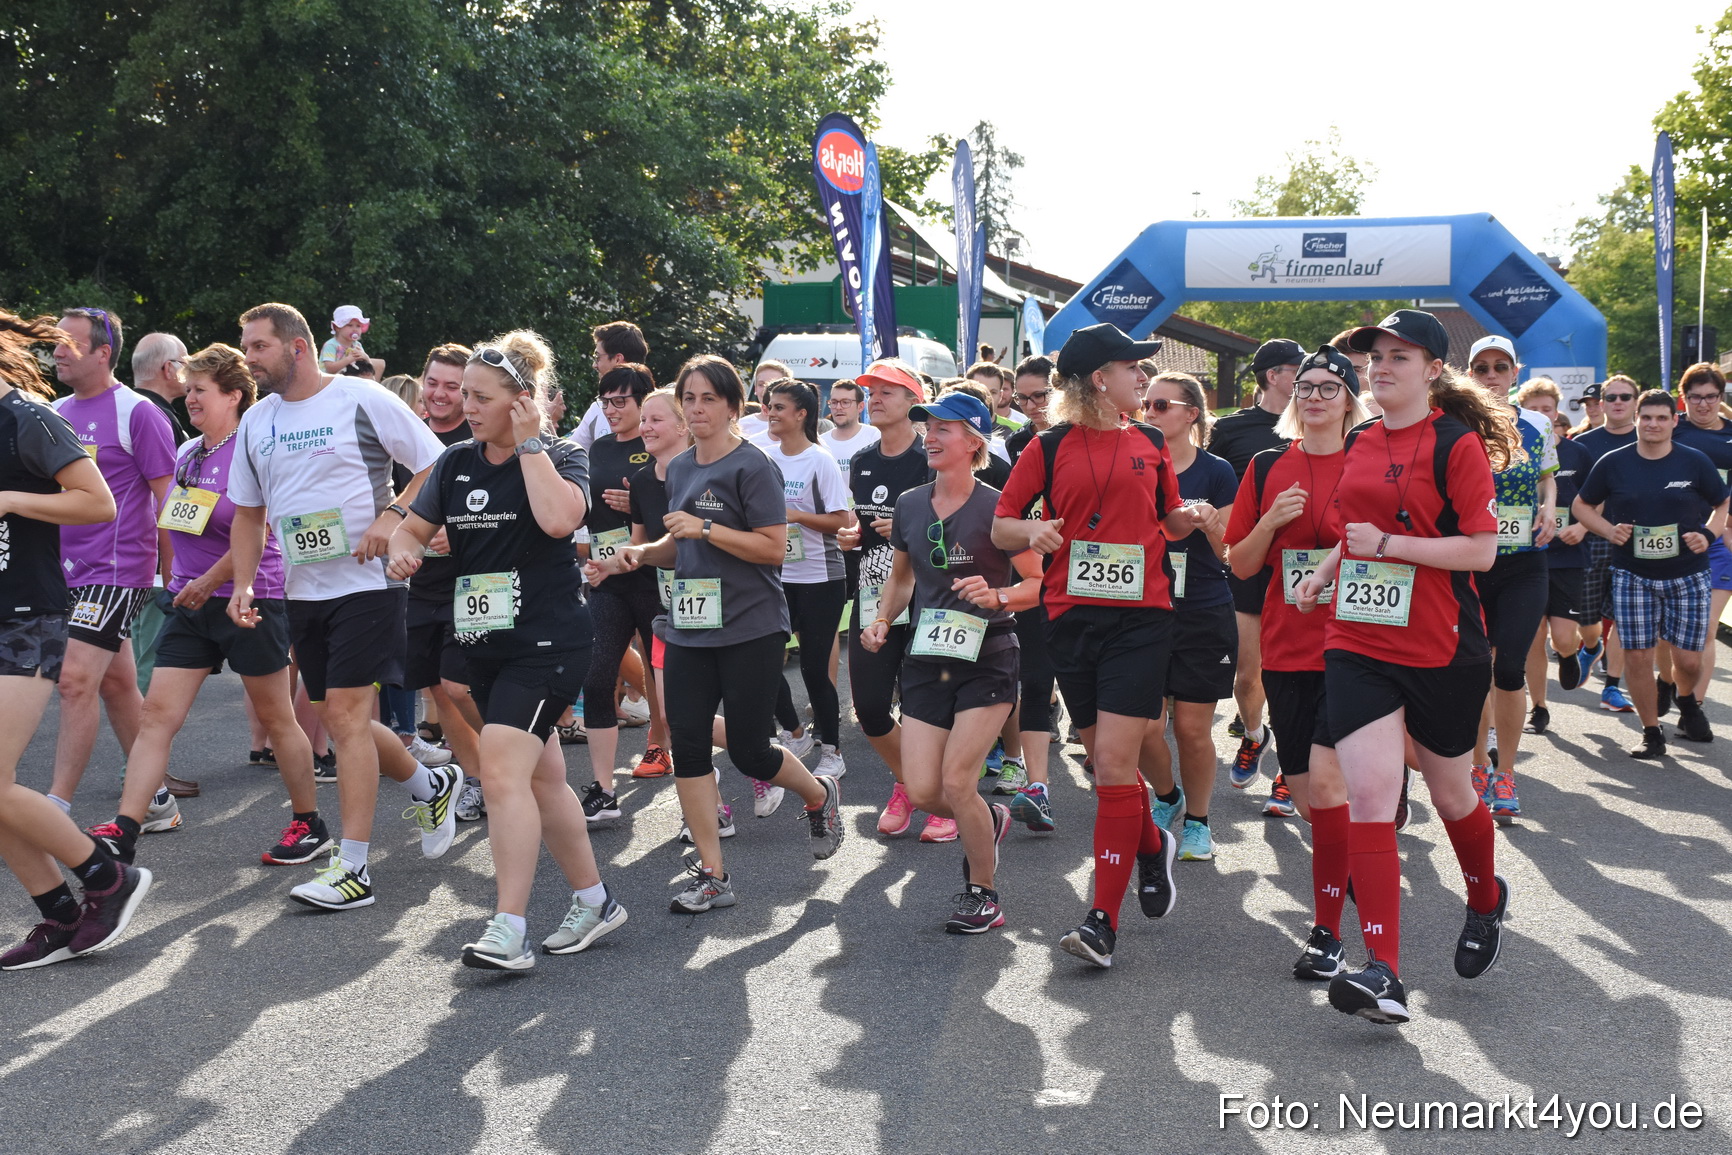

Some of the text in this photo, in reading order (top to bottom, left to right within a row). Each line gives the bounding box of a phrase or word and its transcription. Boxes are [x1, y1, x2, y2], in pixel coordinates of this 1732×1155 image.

[1311, 242, 1344, 250] Fischer
[1286, 258, 1384, 276] firmenlauf
[1102, 292, 1152, 304] Fischer
[280, 426, 334, 442] HAUBNER
[287, 438, 326, 452] TREPPEN
[1130, 456, 1145, 470] 18
[1384, 464, 1404, 478] 20
[172, 502, 198, 520] 888
[456, 522, 498, 530] SCHOTTERWERKE
[296, 529, 331, 550] 998
[1639, 537, 1673, 550] 1463
[1077, 561, 1134, 584] 2356
[1345, 582, 1400, 608] 2330
[467, 594, 489, 616] 96
[678, 597, 706, 615] 417
[75, 612, 95, 621] JUVE
[928, 626, 967, 645] 416
